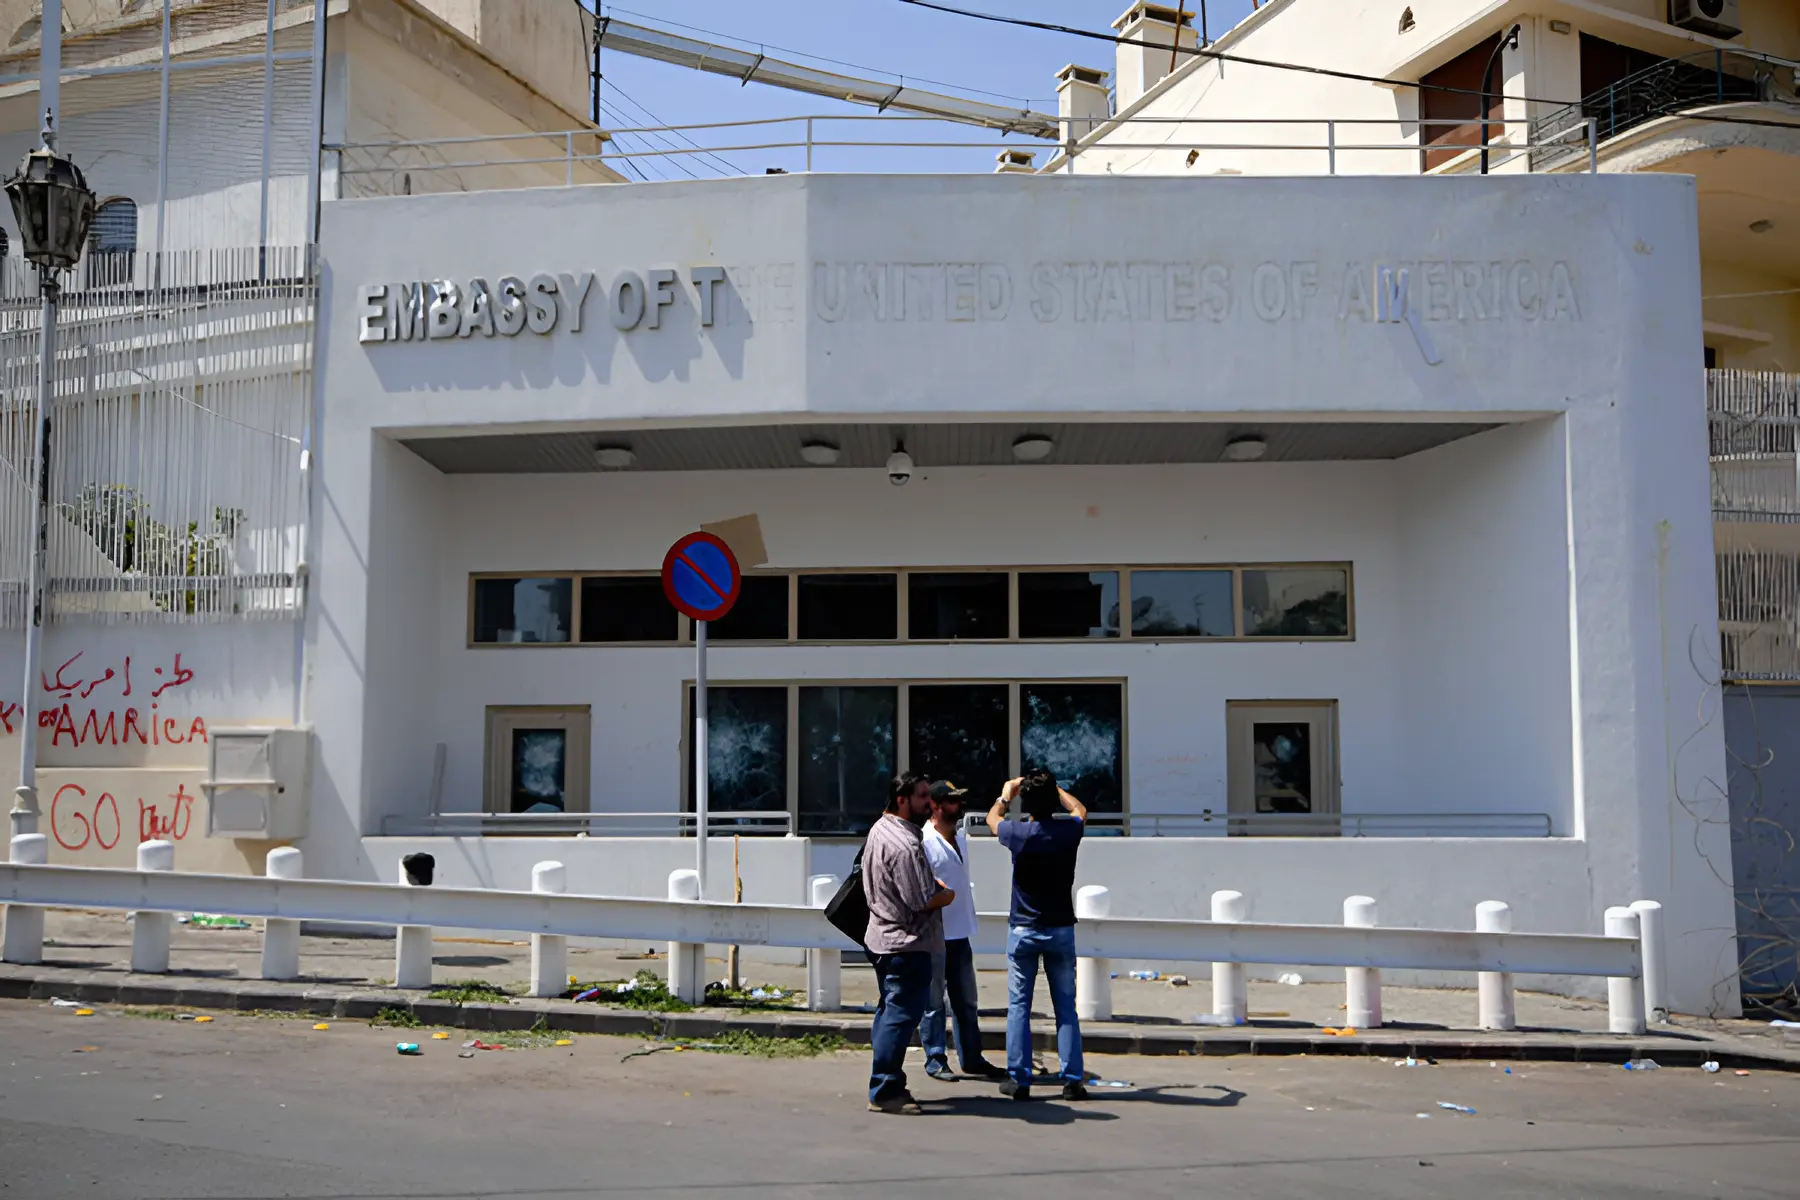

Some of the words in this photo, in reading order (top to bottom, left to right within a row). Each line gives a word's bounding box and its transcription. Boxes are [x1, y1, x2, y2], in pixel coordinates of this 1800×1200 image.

[359, 269, 596, 344] EMBASSY
[609, 268, 677, 331] OF
[813, 260, 1013, 323] UNITED
[1028, 260, 1233, 323] STATES
[1250, 260, 1319, 323] OF
[1338, 260, 1583, 323] AMERICA
[51, 783, 121, 851] GO
